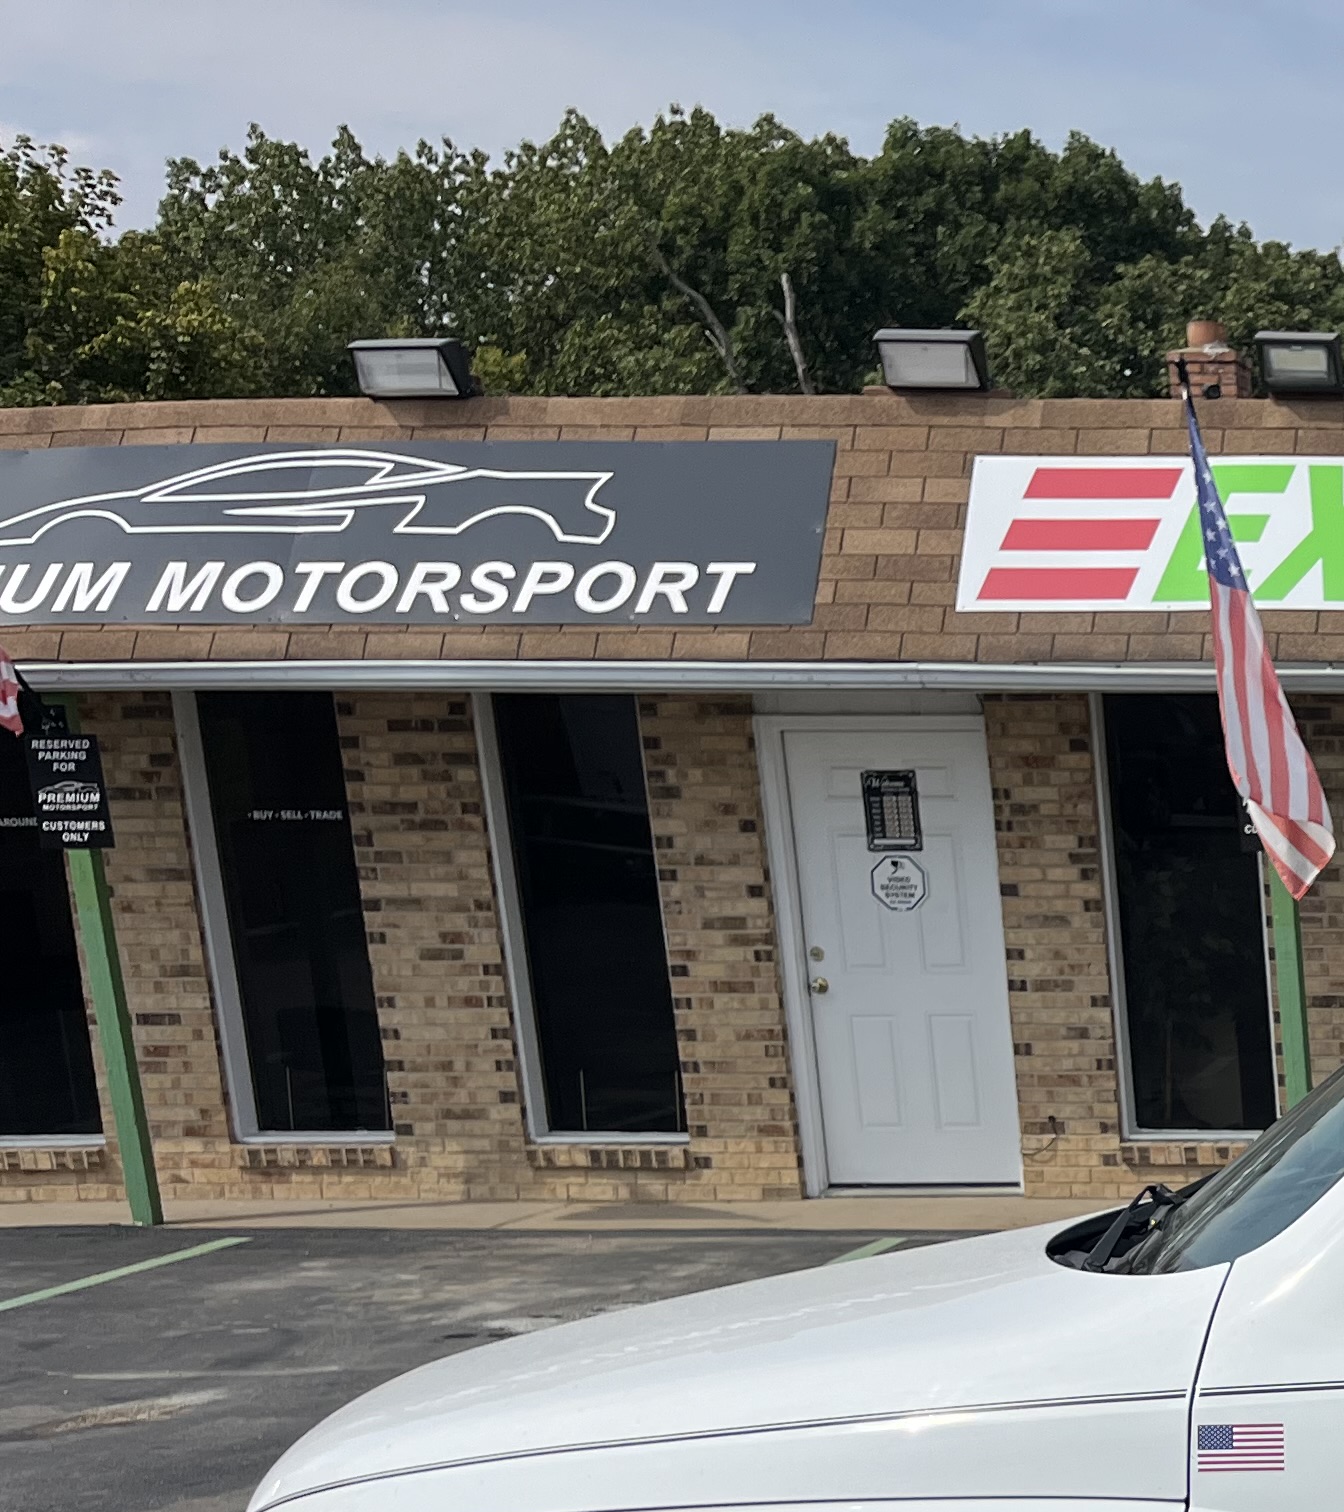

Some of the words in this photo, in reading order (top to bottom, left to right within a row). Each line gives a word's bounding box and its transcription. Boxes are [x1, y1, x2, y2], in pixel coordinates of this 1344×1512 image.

[0, 562, 131, 614] UM
[146, 562, 756, 614] MOTORSPORT
[31, 739, 90, 750] RESERVED
[38, 750, 87, 761] PARKING
[52, 762, 76, 772] FOR
[38, 792, 100, 803] PREMIUM
[42, 803, 98, 811] MOTORSPORT
[253, 809, 274, 820] BUY
[280, 809, 303, 820] SELL
[309, 809, 343, 820] TRADE
[42, 820, 106, 831] CUSTOMERS
[62, 832, 90, 842] ONLY
